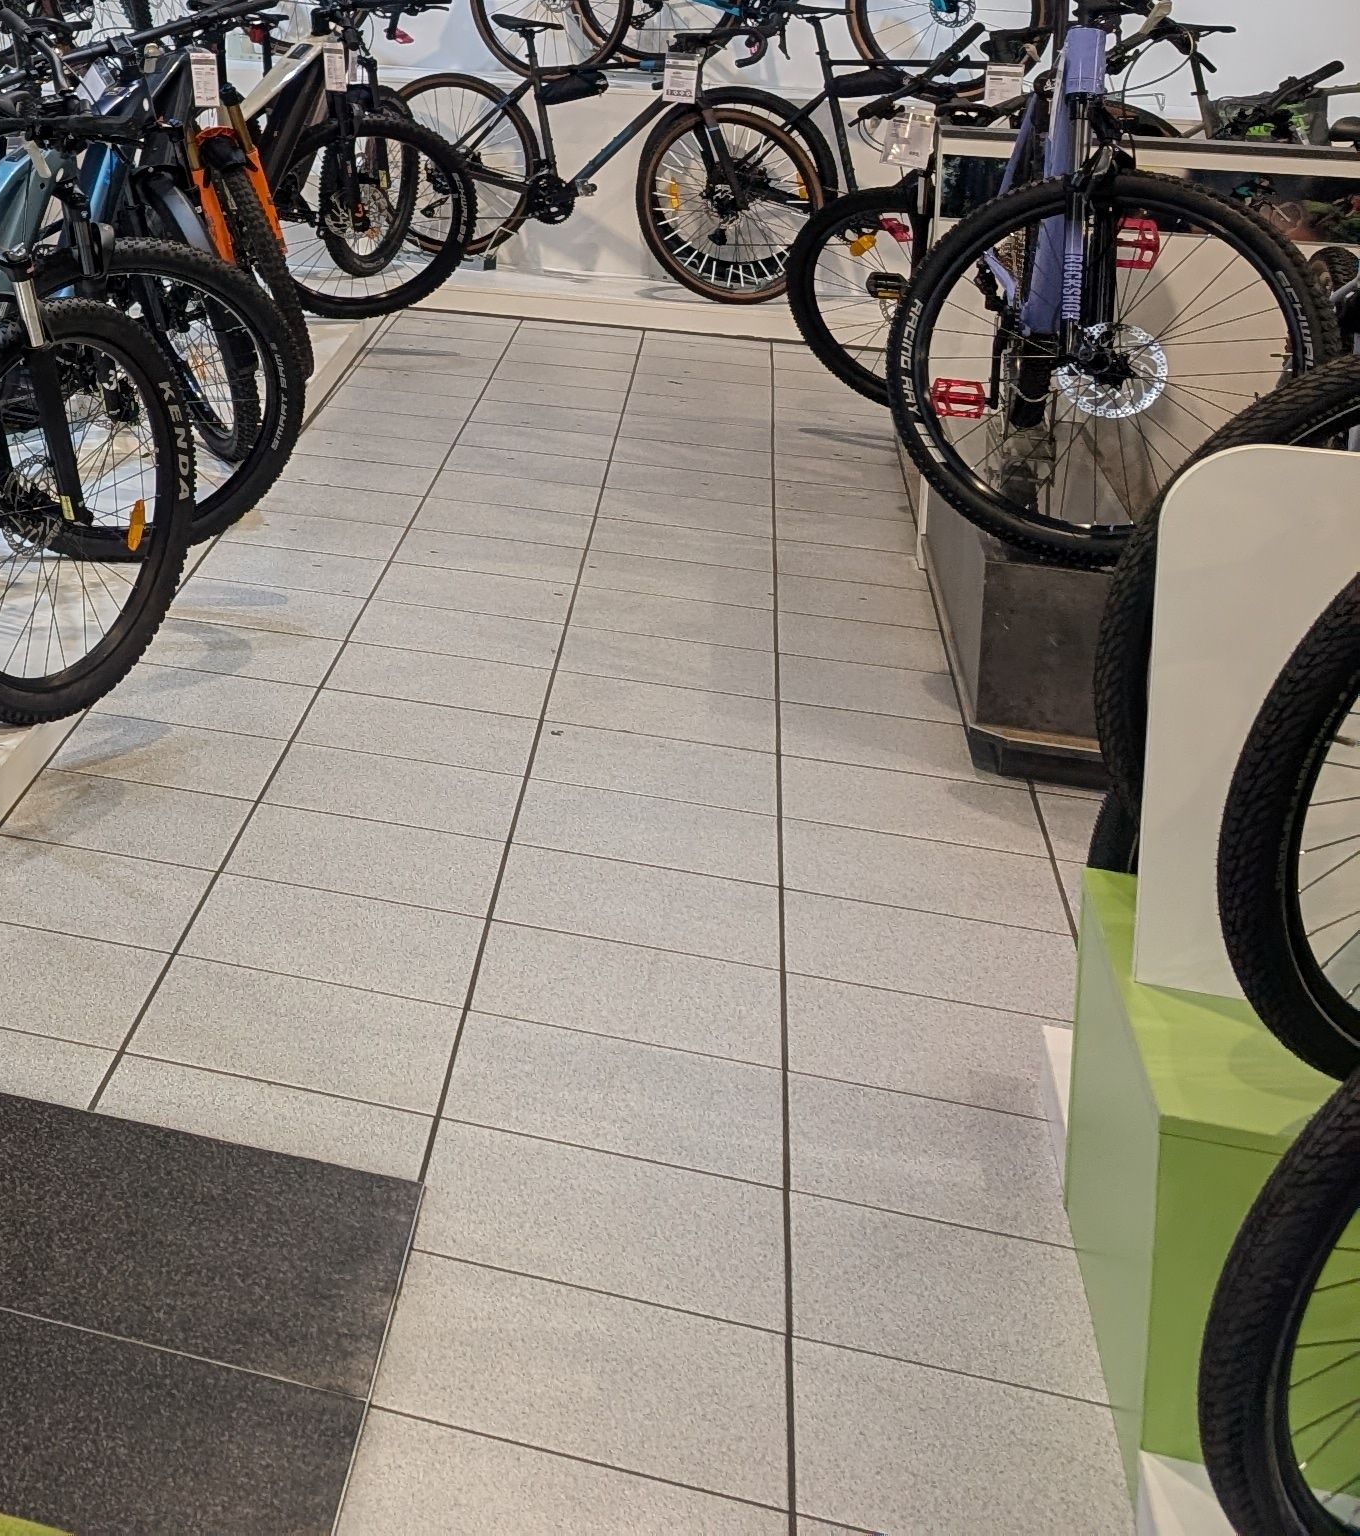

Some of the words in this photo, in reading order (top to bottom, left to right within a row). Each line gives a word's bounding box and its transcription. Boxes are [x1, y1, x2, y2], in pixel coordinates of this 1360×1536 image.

[1061, 254, 1084, 321] ROCKSHOX
[1275, 270, 1314, 374] SCHWAL
[900, 298, 924, 369] RACING
[900, 375, 922, 417] RAY
[157, 381, 191, 501] KENDA
